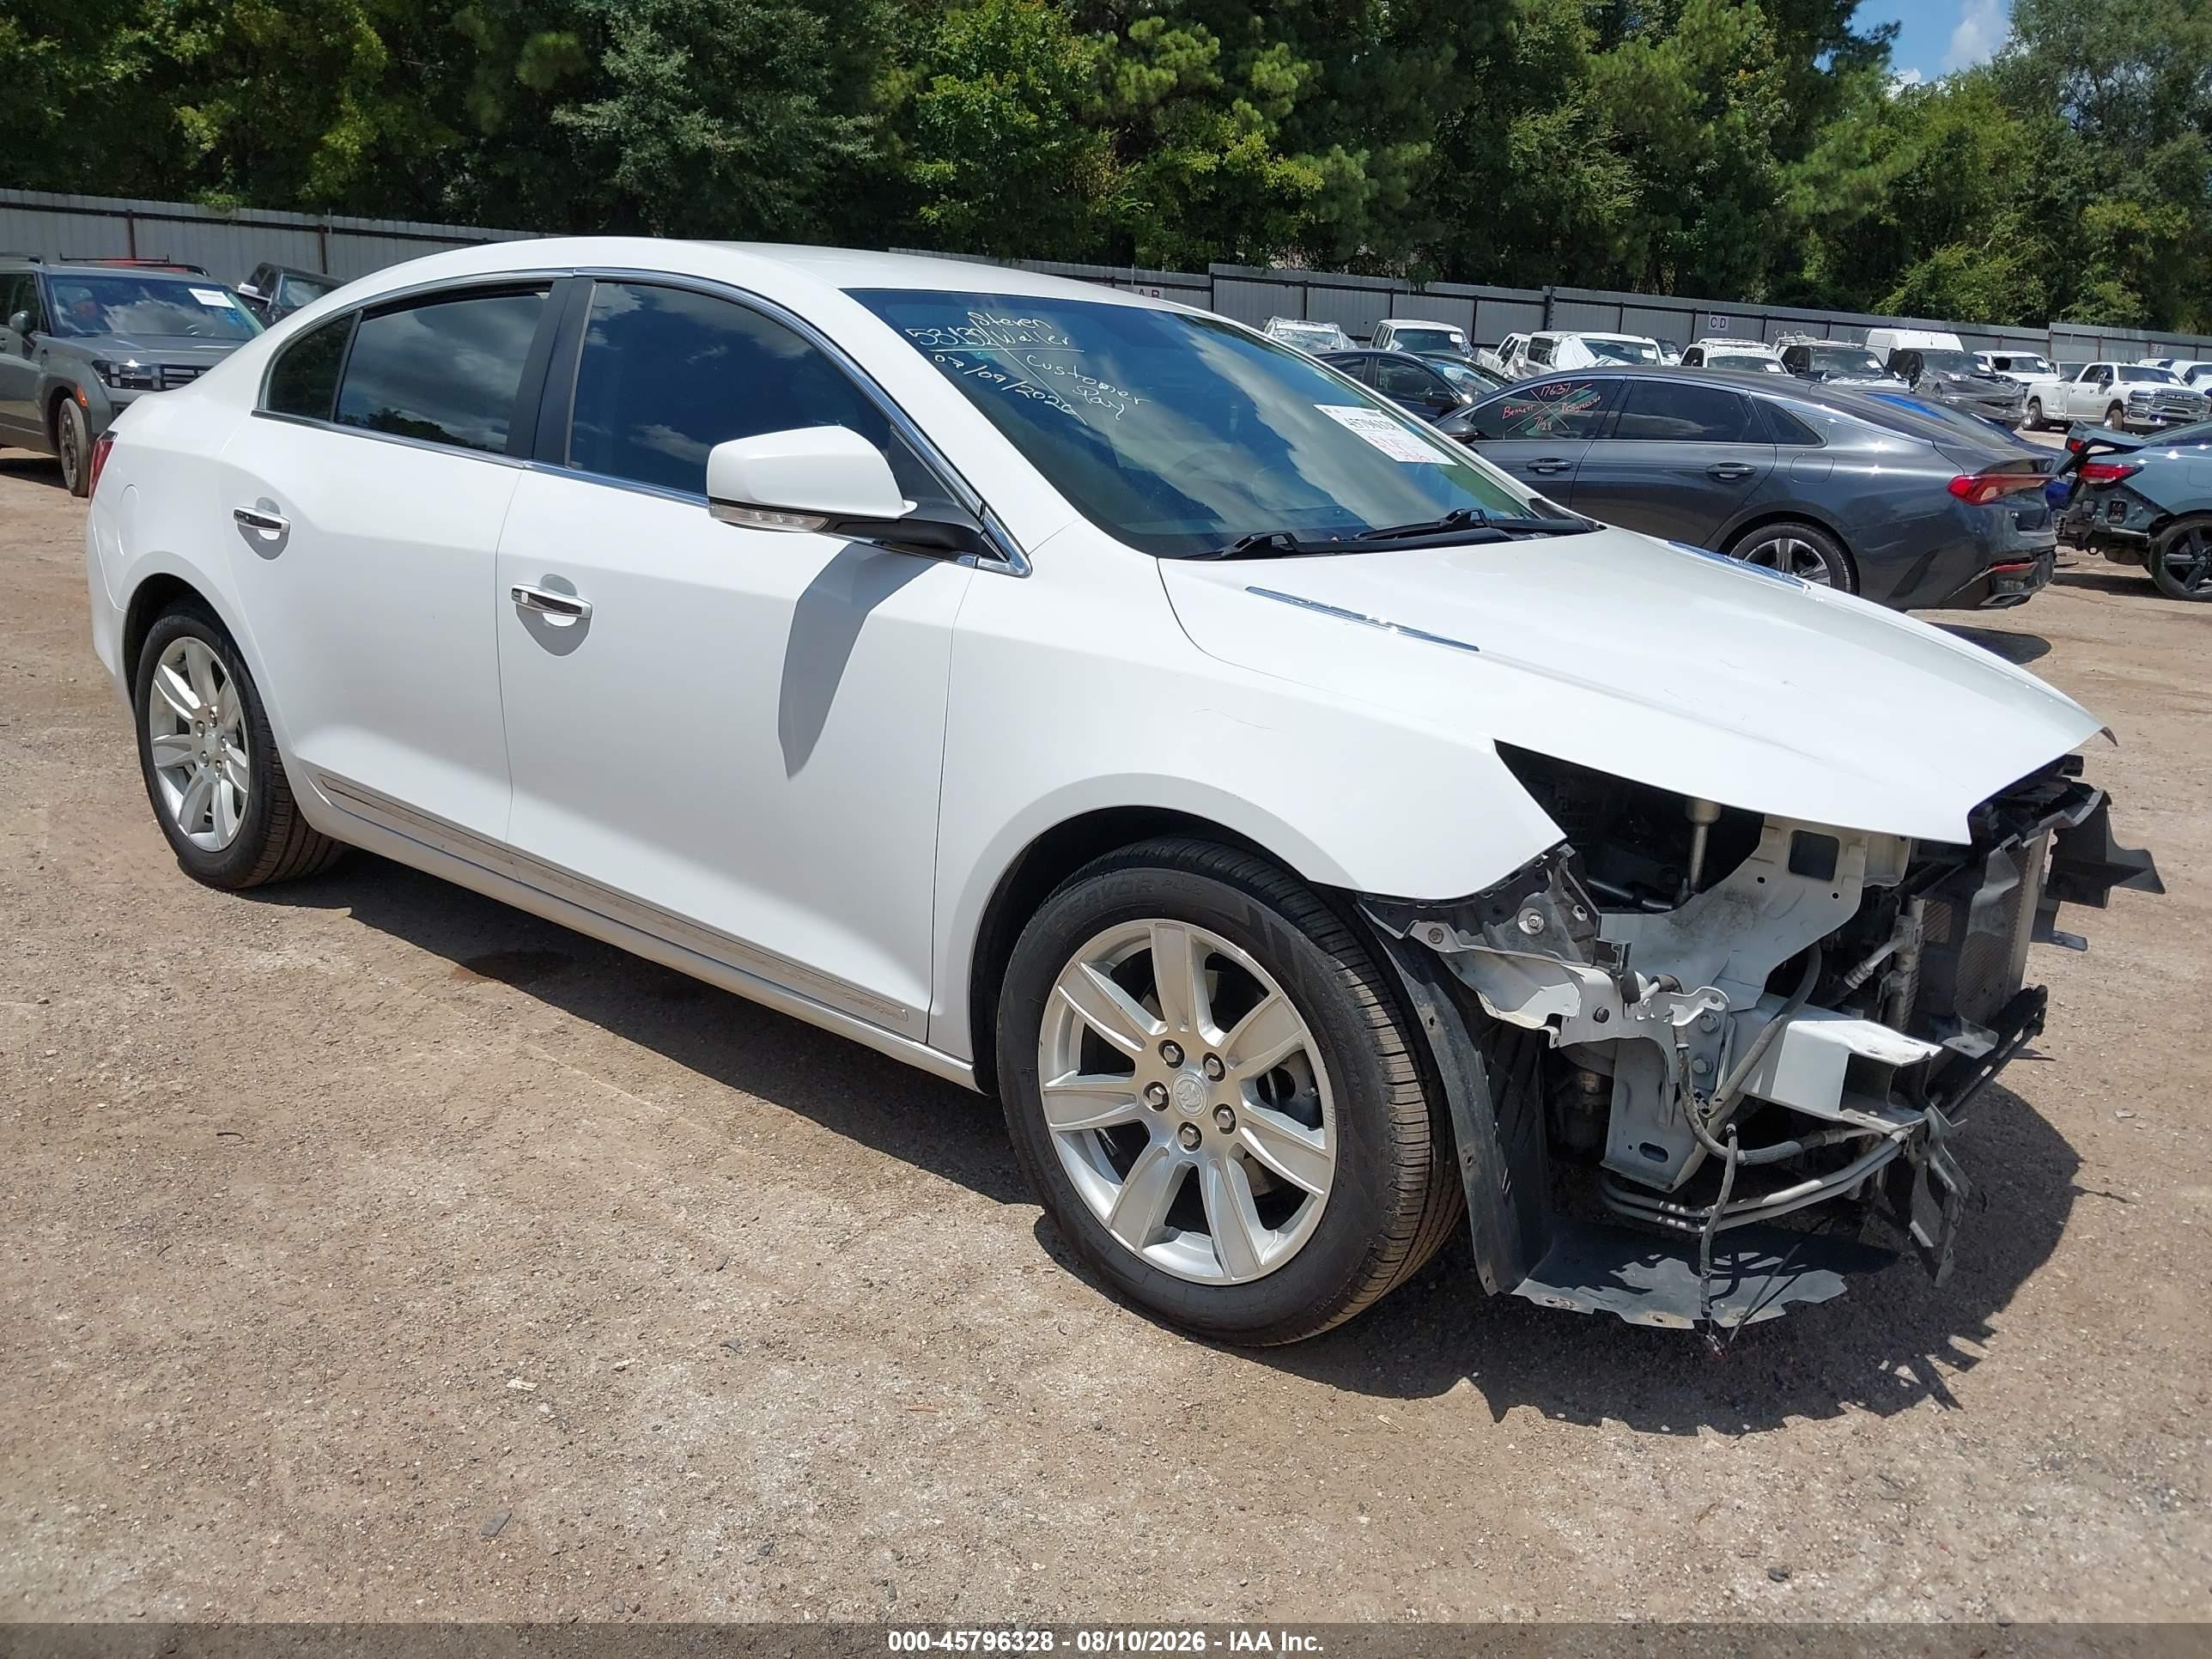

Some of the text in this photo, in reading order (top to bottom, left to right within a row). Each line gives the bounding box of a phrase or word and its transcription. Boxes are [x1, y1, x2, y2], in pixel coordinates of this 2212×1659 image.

[967, 312, 1053, 330] Steven
[990, 328, 1070, 346] Waller
[1026, 355, 1152, 406] Customer
[1540, 383, 1571, 397] 17637
[1072, 386, 1126, 421] Pay
